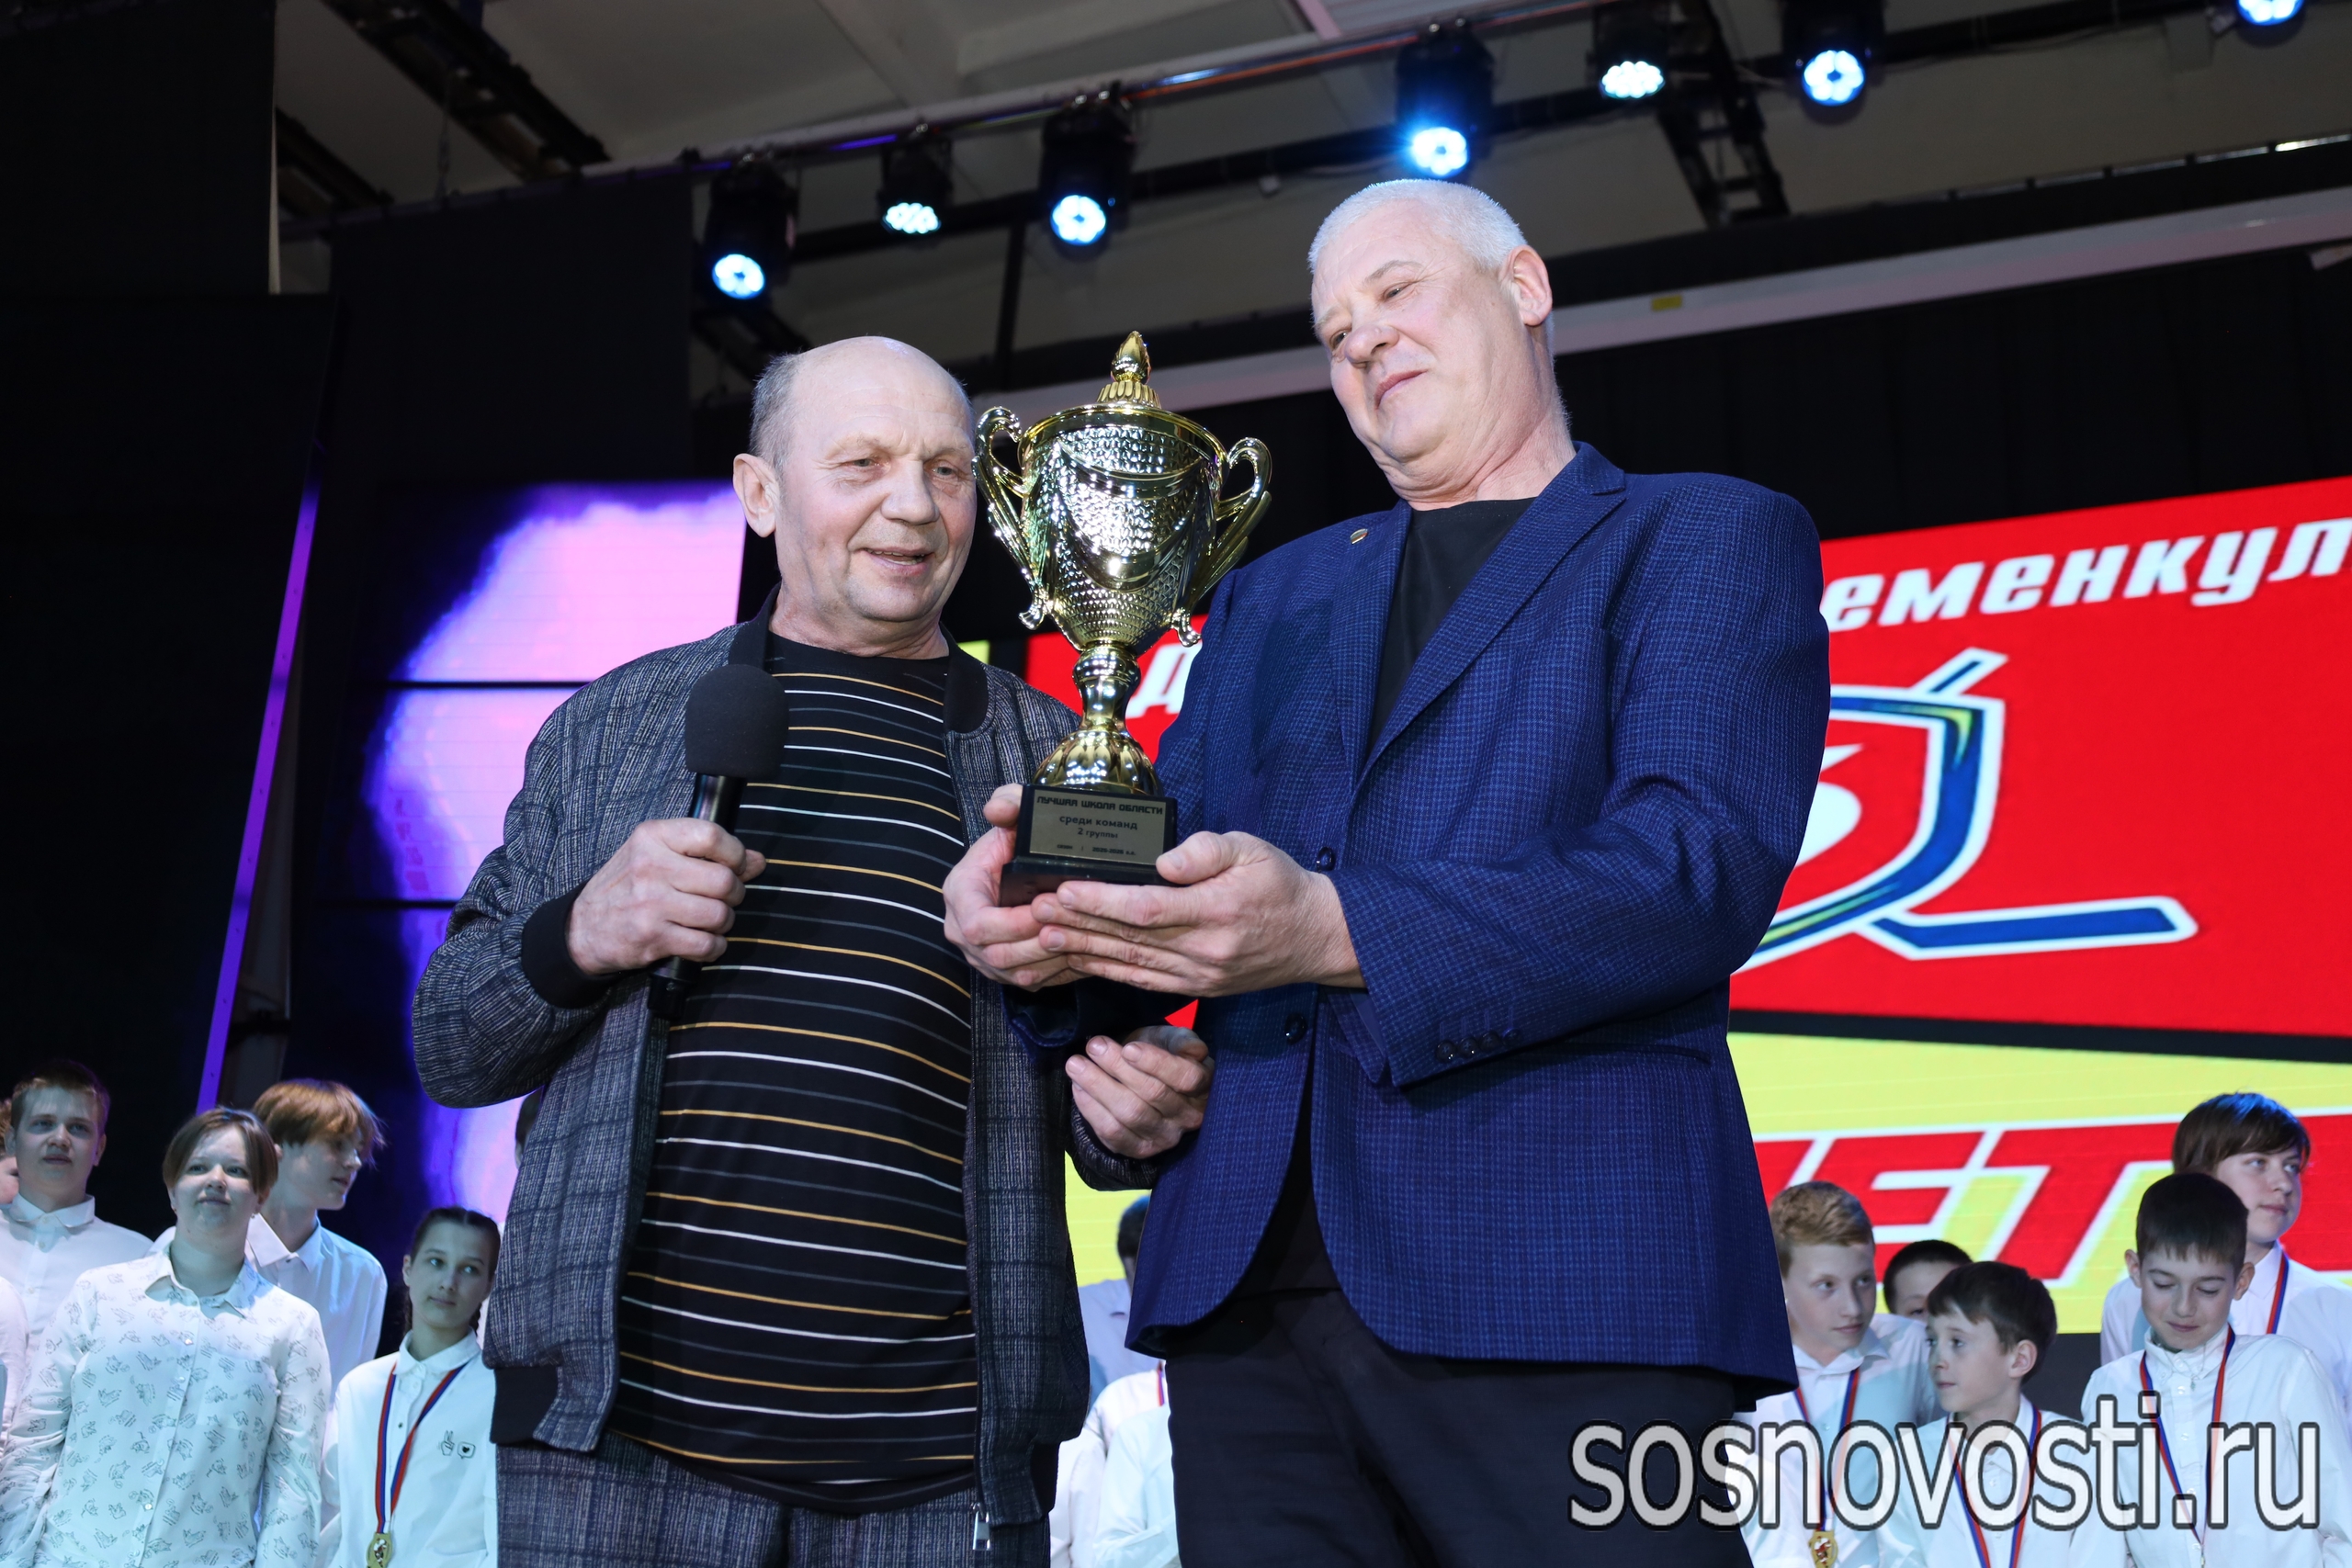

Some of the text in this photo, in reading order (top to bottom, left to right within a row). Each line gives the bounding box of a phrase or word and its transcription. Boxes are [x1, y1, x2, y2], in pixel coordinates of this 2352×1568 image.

[1125, 517, 2352, 719] Д еменкул
[1036, 795, 1163, 815] ЛУЧШАЯ ШКОЛА ОБЛАСТИ
[1059, 816, 1137, 830] среди команд
[1078, 828, 1118, 839] 2 группы
